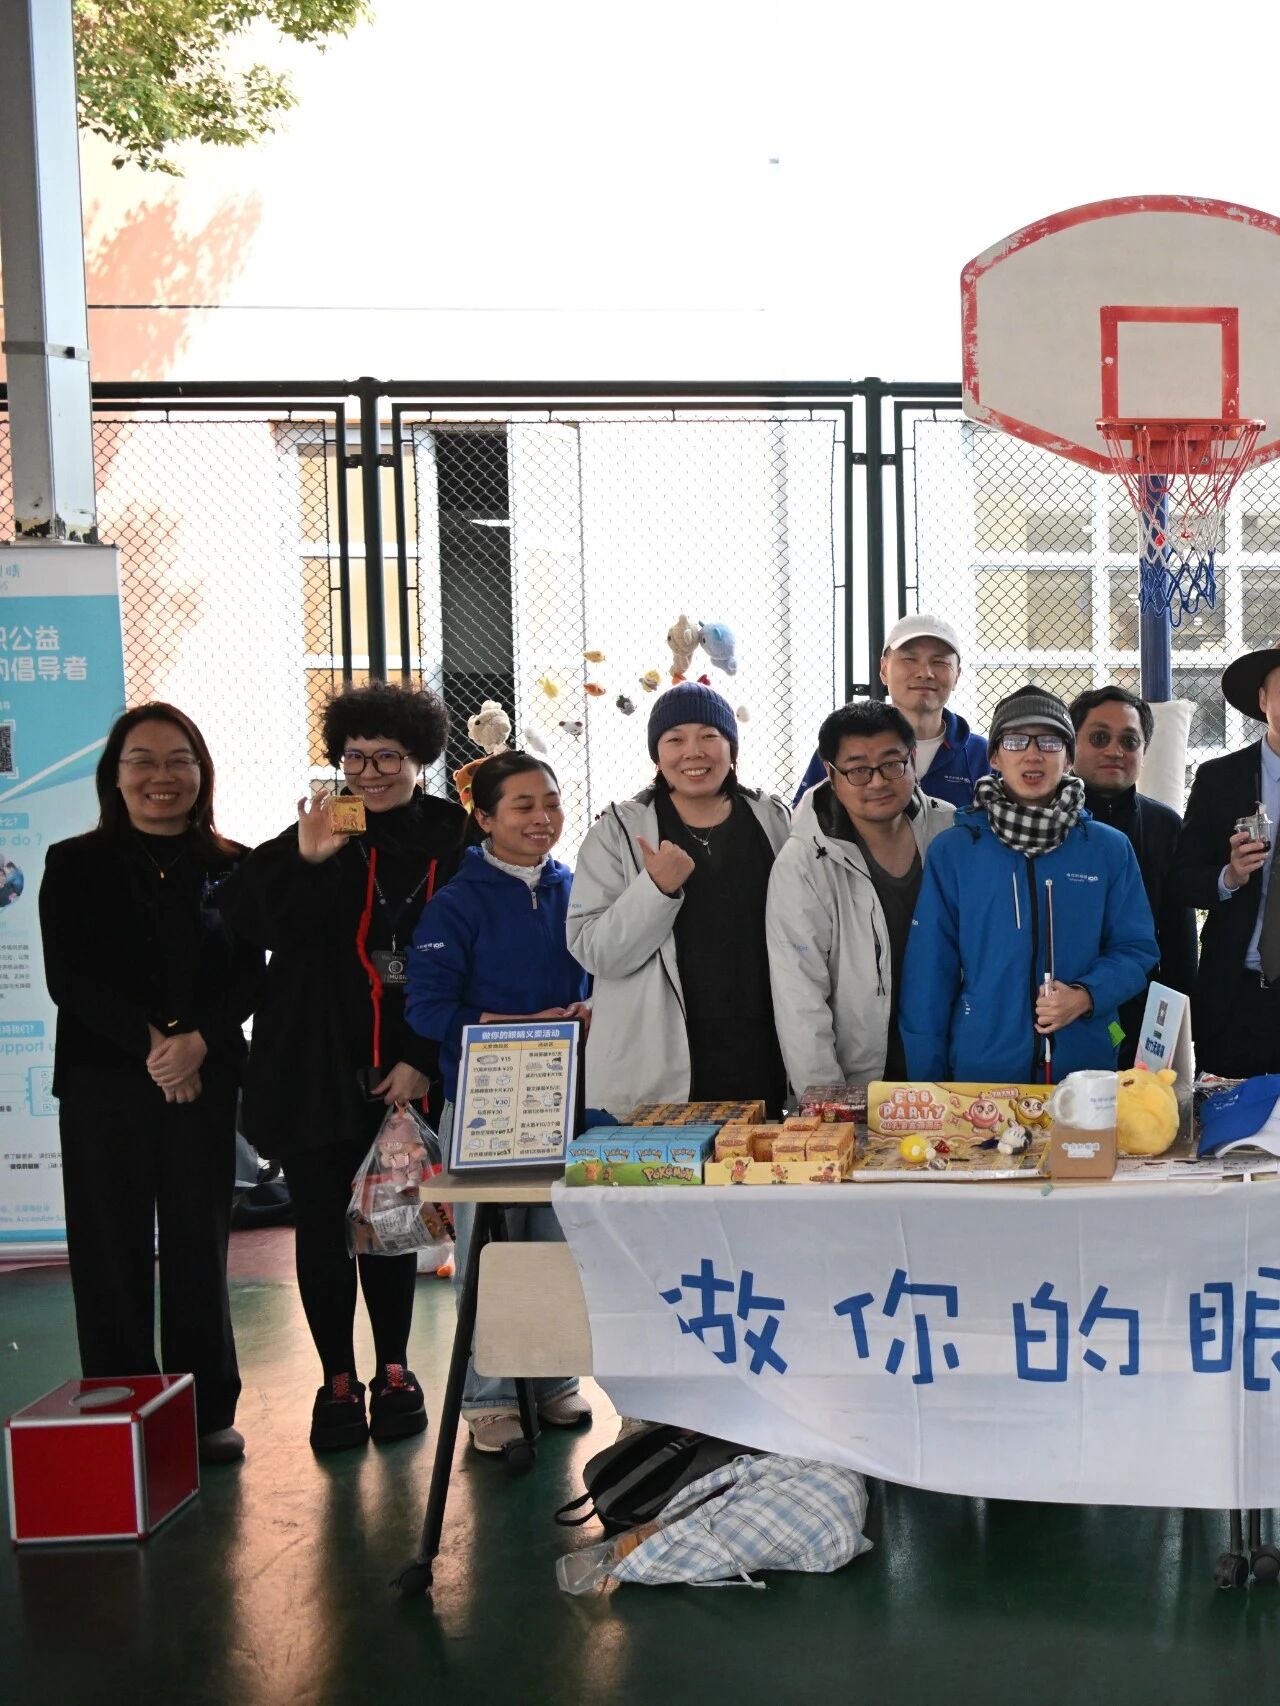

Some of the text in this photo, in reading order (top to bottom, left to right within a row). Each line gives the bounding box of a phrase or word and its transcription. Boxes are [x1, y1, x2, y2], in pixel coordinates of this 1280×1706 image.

[482, 1029, 561, 1040] 做你的眼睛义卖活动
[893, 1089, 931, 1105] EGG
[882, 1104, 945, 1120] PARTY
